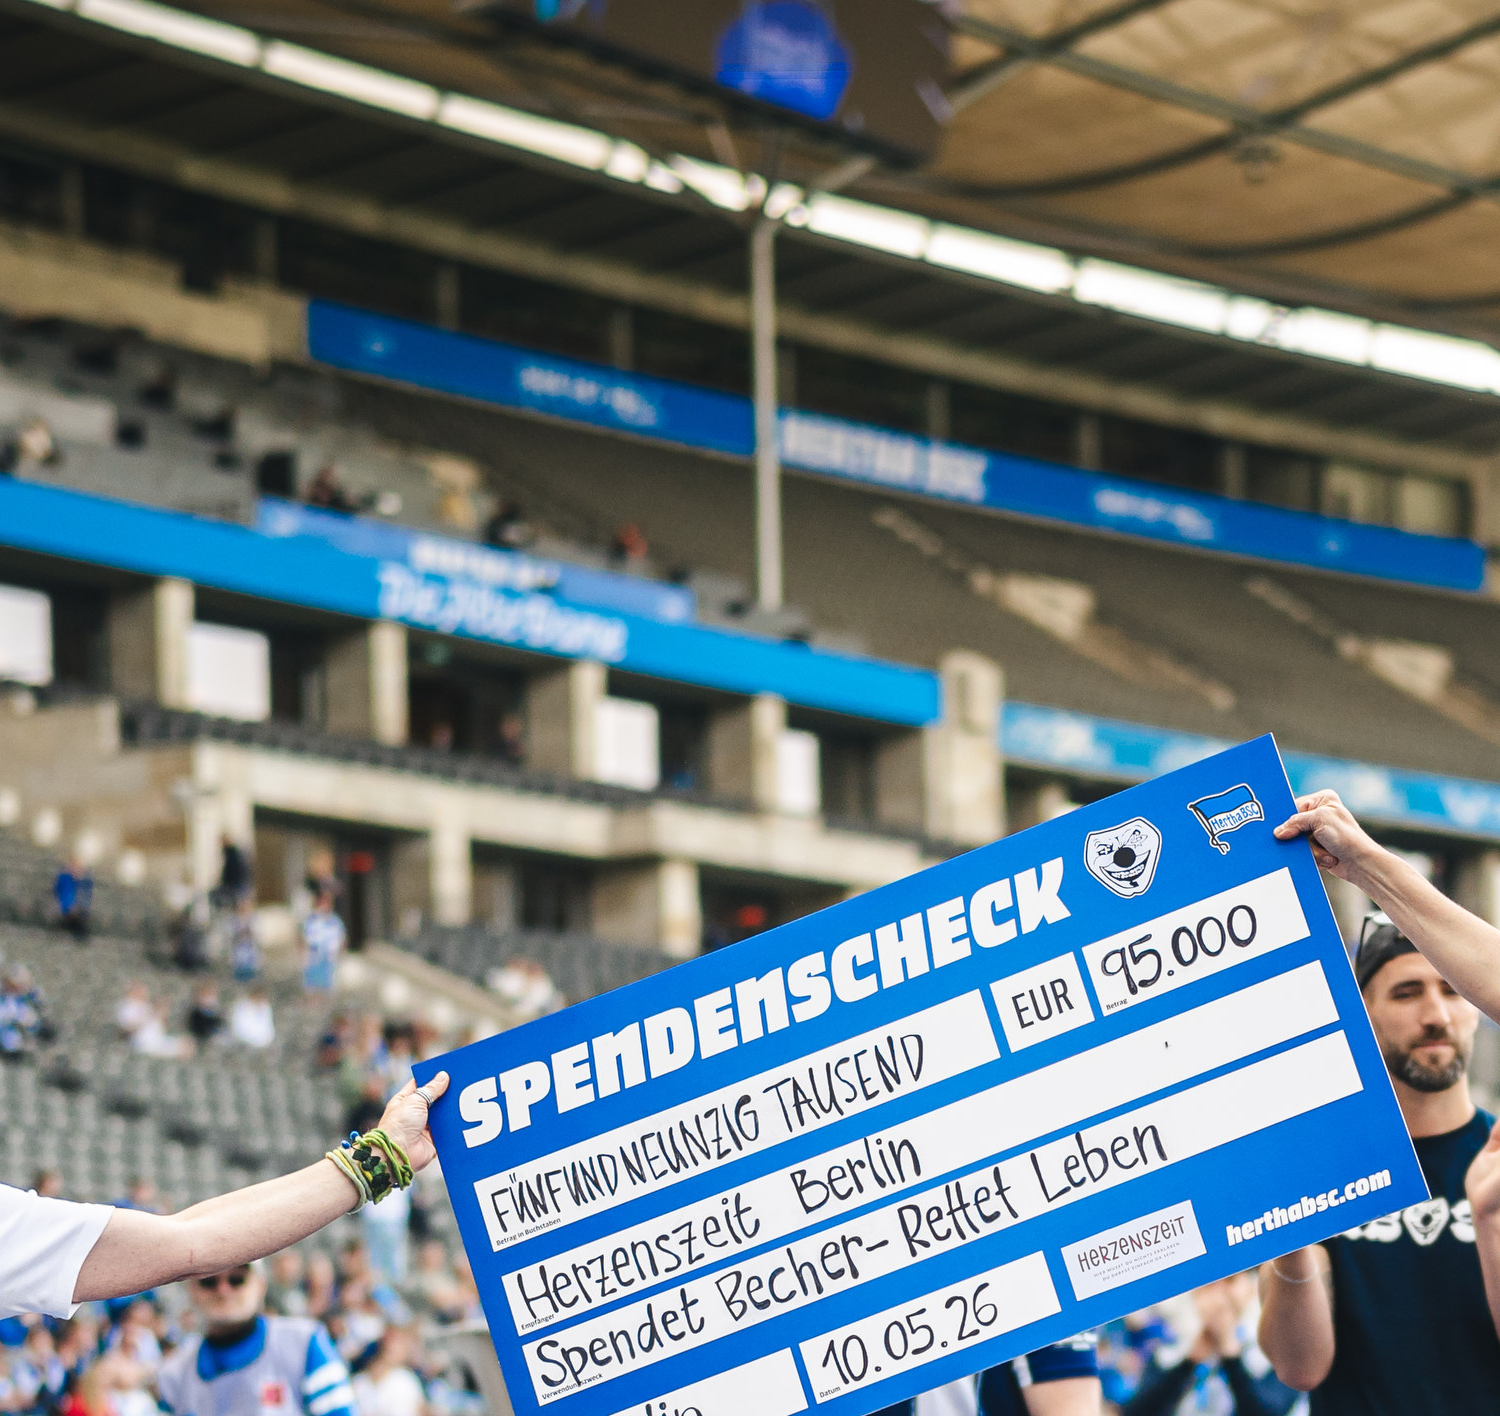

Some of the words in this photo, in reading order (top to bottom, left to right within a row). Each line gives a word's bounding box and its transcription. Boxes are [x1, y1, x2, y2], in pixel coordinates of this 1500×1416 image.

[1100, 904, 1258, 996] 95.000
[459, 856, 1072, 1149] SPENDENSCHECK
[1011, 978, 1075, 1030] EUR
[1105, 998, 1129, 1012] Betrag
[762, 1034, 924, 1133] TAUSEND
[496, 1234, 518, 1247] Betrag
[524, 1217, 562, 1237] Buchstaben
[516, 1192, 761, 1320] Herzenszeit
[789, 1137, 921, 1214] Berlin
[1225, 1168, 1392, 1247] herthabsc.com
[536, 1287, 705, 1388] Spendet
[1030, 1124, 1168, 1204] Leben
[520, 1312, 556, 1332] Empfänger
[822, 1282, 999, 1386] 10.05.26
[541, 1371, 604, 1400] Verwendunszweck
[819, 1386, 842, 1399] Datum
